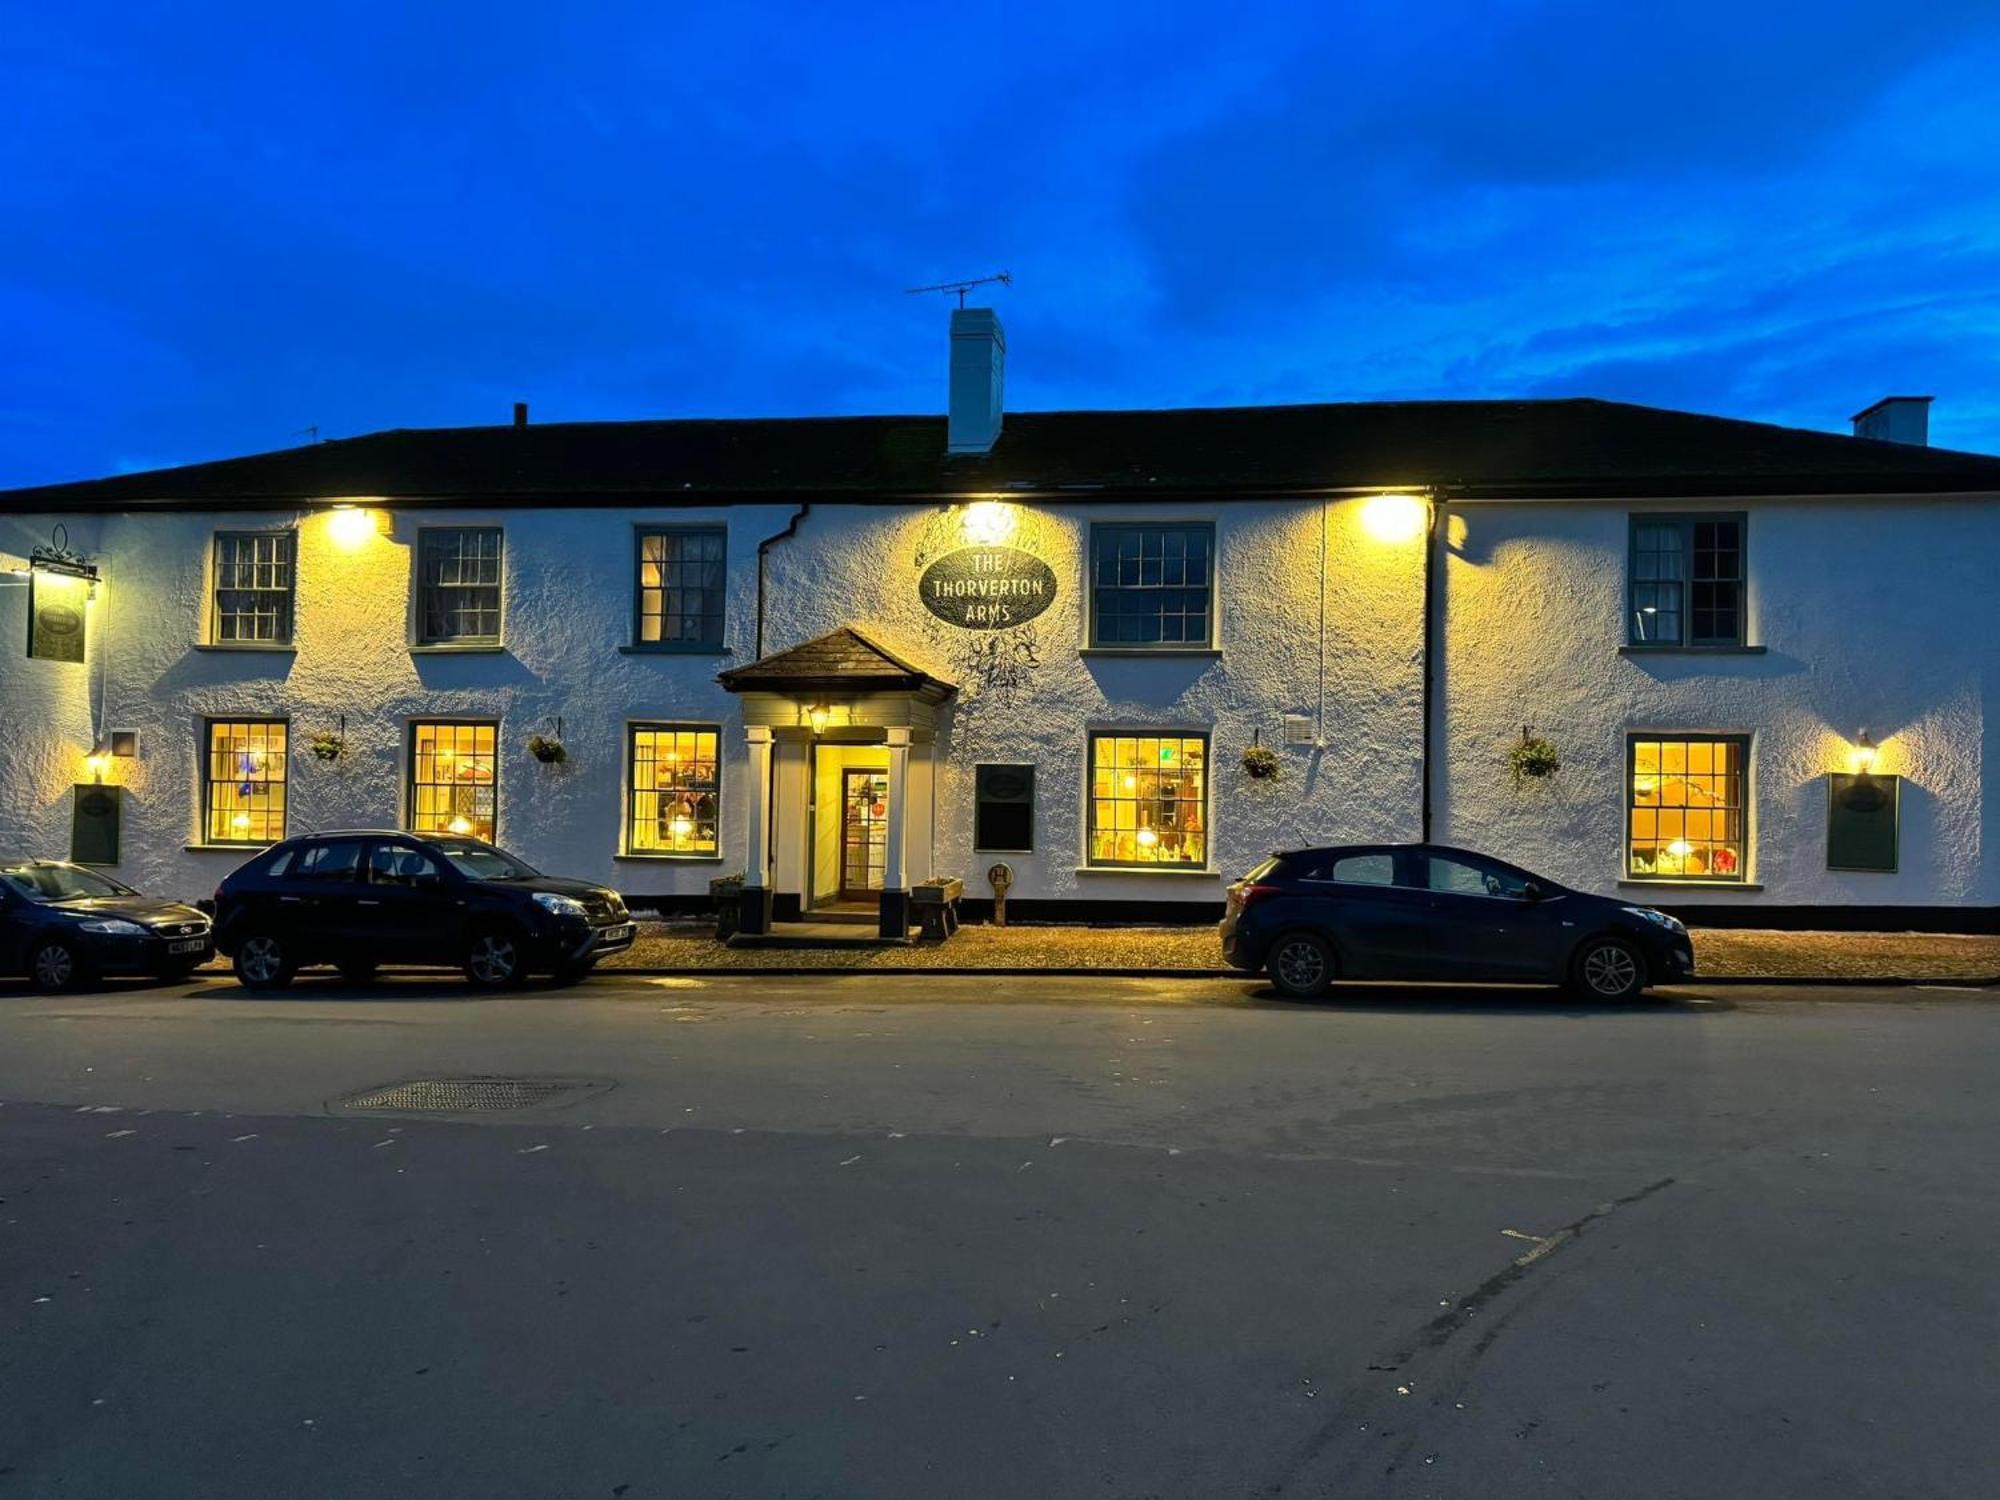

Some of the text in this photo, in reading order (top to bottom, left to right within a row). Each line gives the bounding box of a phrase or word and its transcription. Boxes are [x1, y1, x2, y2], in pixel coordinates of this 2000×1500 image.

[973, 555, 1003, 572] THE
[934, 579, 1042, 597] THORVERTON
[965, 603, 1010, 621] ARMS
